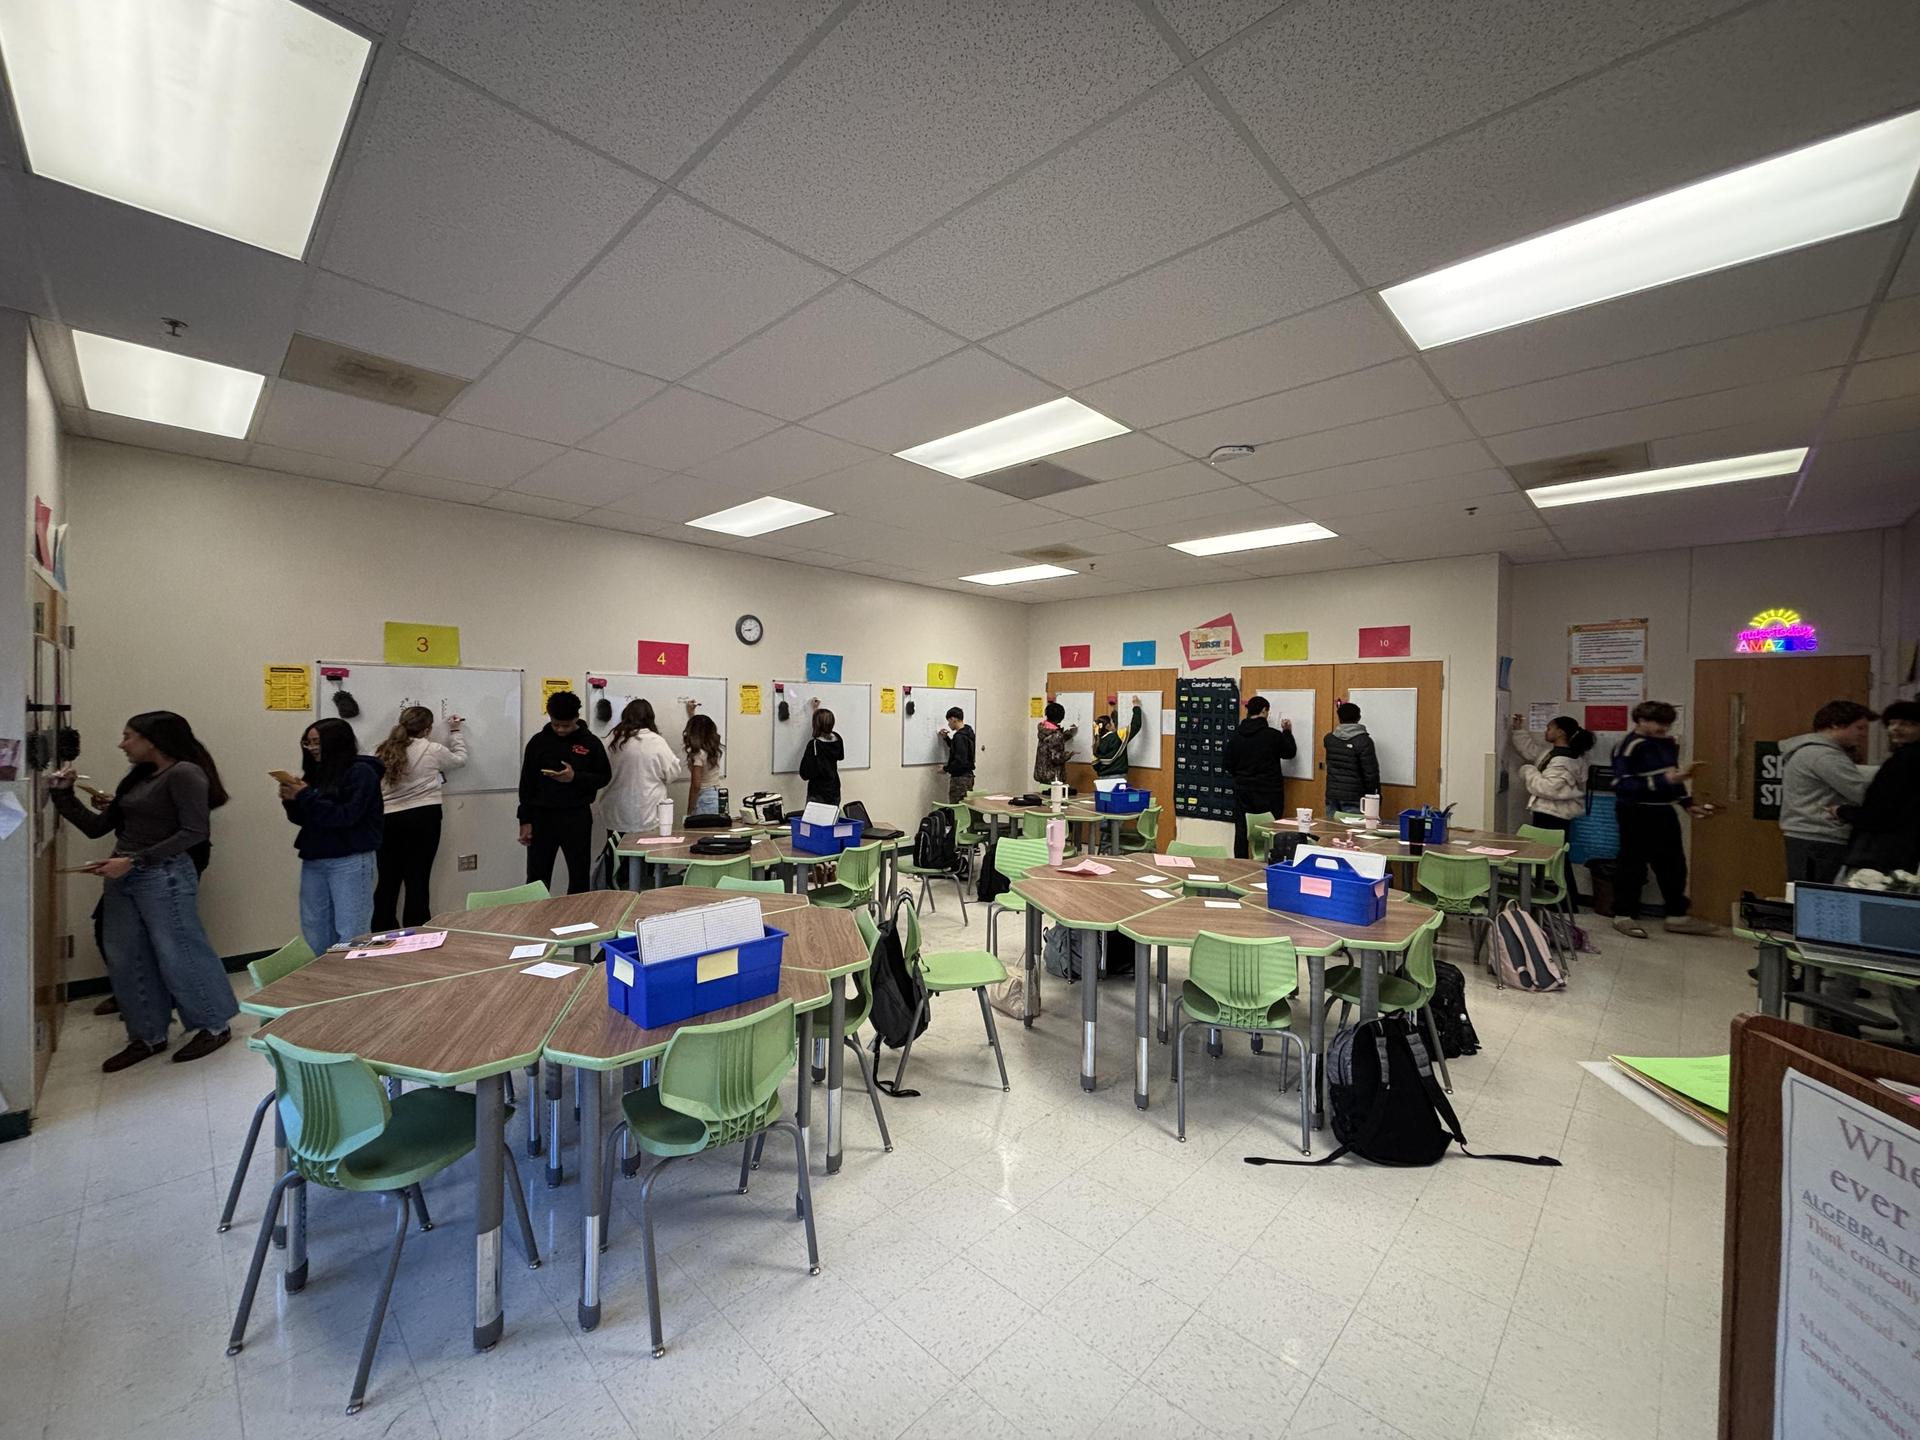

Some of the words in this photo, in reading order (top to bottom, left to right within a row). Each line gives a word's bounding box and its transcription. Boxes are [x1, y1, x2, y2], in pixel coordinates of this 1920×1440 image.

[416, 636, 429, 653] 3
[1736, 638, 1817, 653] AMAZING
[657, 652, 666, 665] 4
[1073, 652, 1079, 662] 7
[820, 662, 827, 674] 5
[938, 670, 944, 681] 6
[1830, 1169, 1910, 1230] ever
[1802, 1190, 1889, 1254] ALGEBRA
[1806, 1213, 1847, 1254] Think
